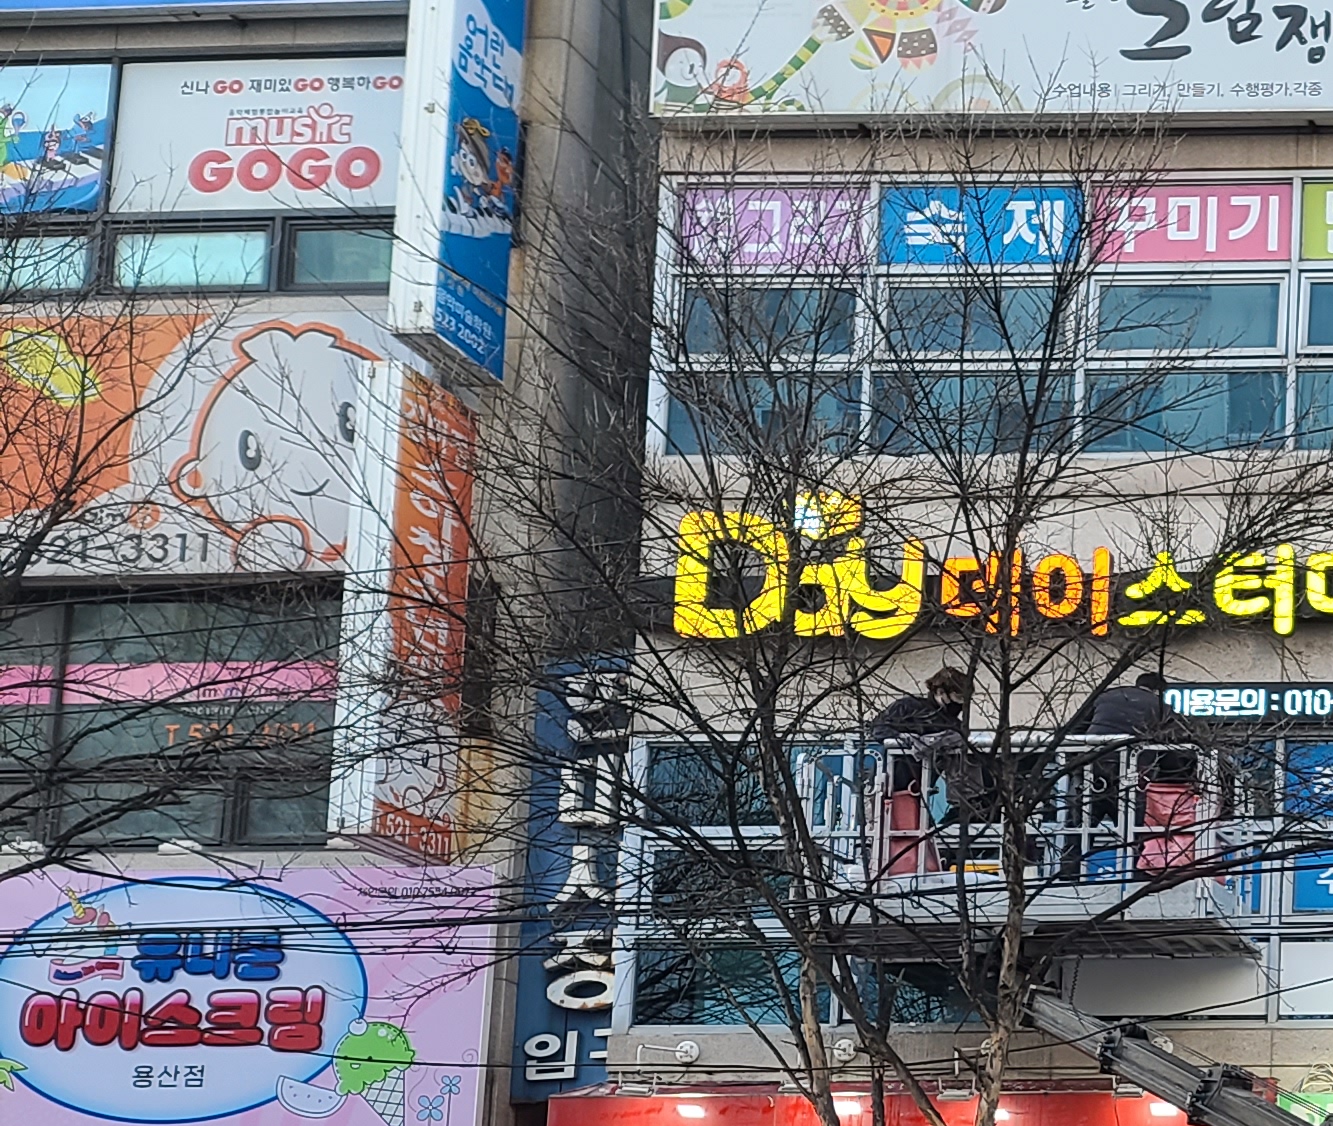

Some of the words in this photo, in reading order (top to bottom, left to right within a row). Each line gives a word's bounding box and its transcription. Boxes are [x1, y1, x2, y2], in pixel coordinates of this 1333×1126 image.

[326, 75, 404, 93] 행복하GO
[1050, 80, 1112, 98] 수업내용
[225, 103, 354, 147] music
[187, 146, 382, 194] GOGO
[131, 929, 285, 982] 유니콘
[19, 984, 326, 1051] 아이스크림
[131, 1064, 206, 1089] 용산점
